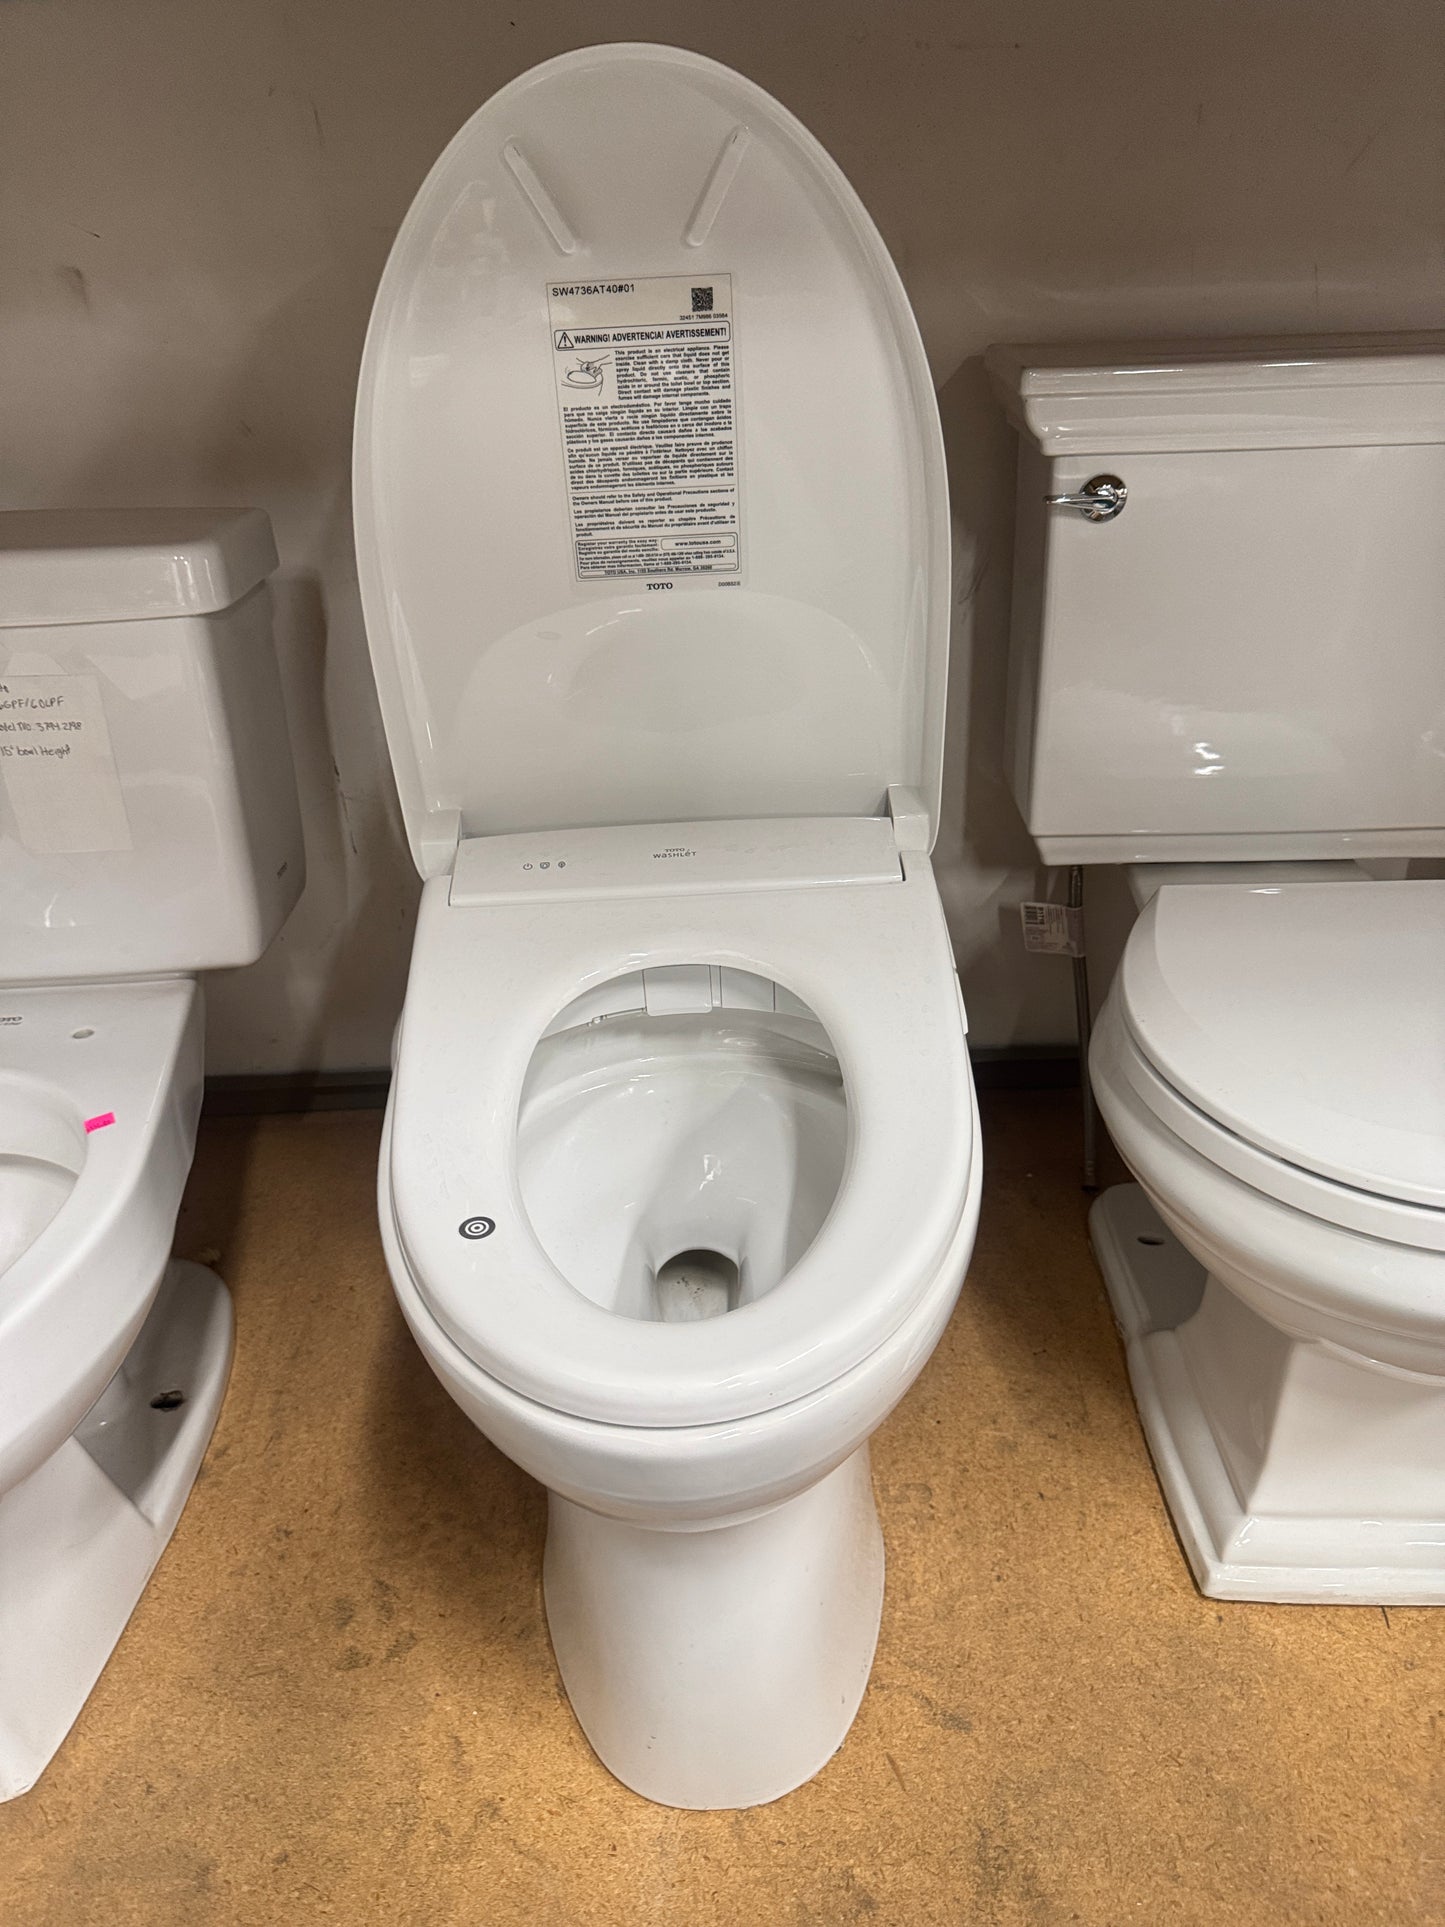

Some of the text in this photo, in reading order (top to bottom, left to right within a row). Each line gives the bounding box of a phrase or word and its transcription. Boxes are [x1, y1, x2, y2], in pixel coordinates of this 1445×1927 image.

[552, 283, 635, 297] SW4736AT40#01
[574, 327, 727, 344] WARNING! ADVERTENCIA! AVERTISSEMENT!
[646, 582, 674, 591] TOTO
